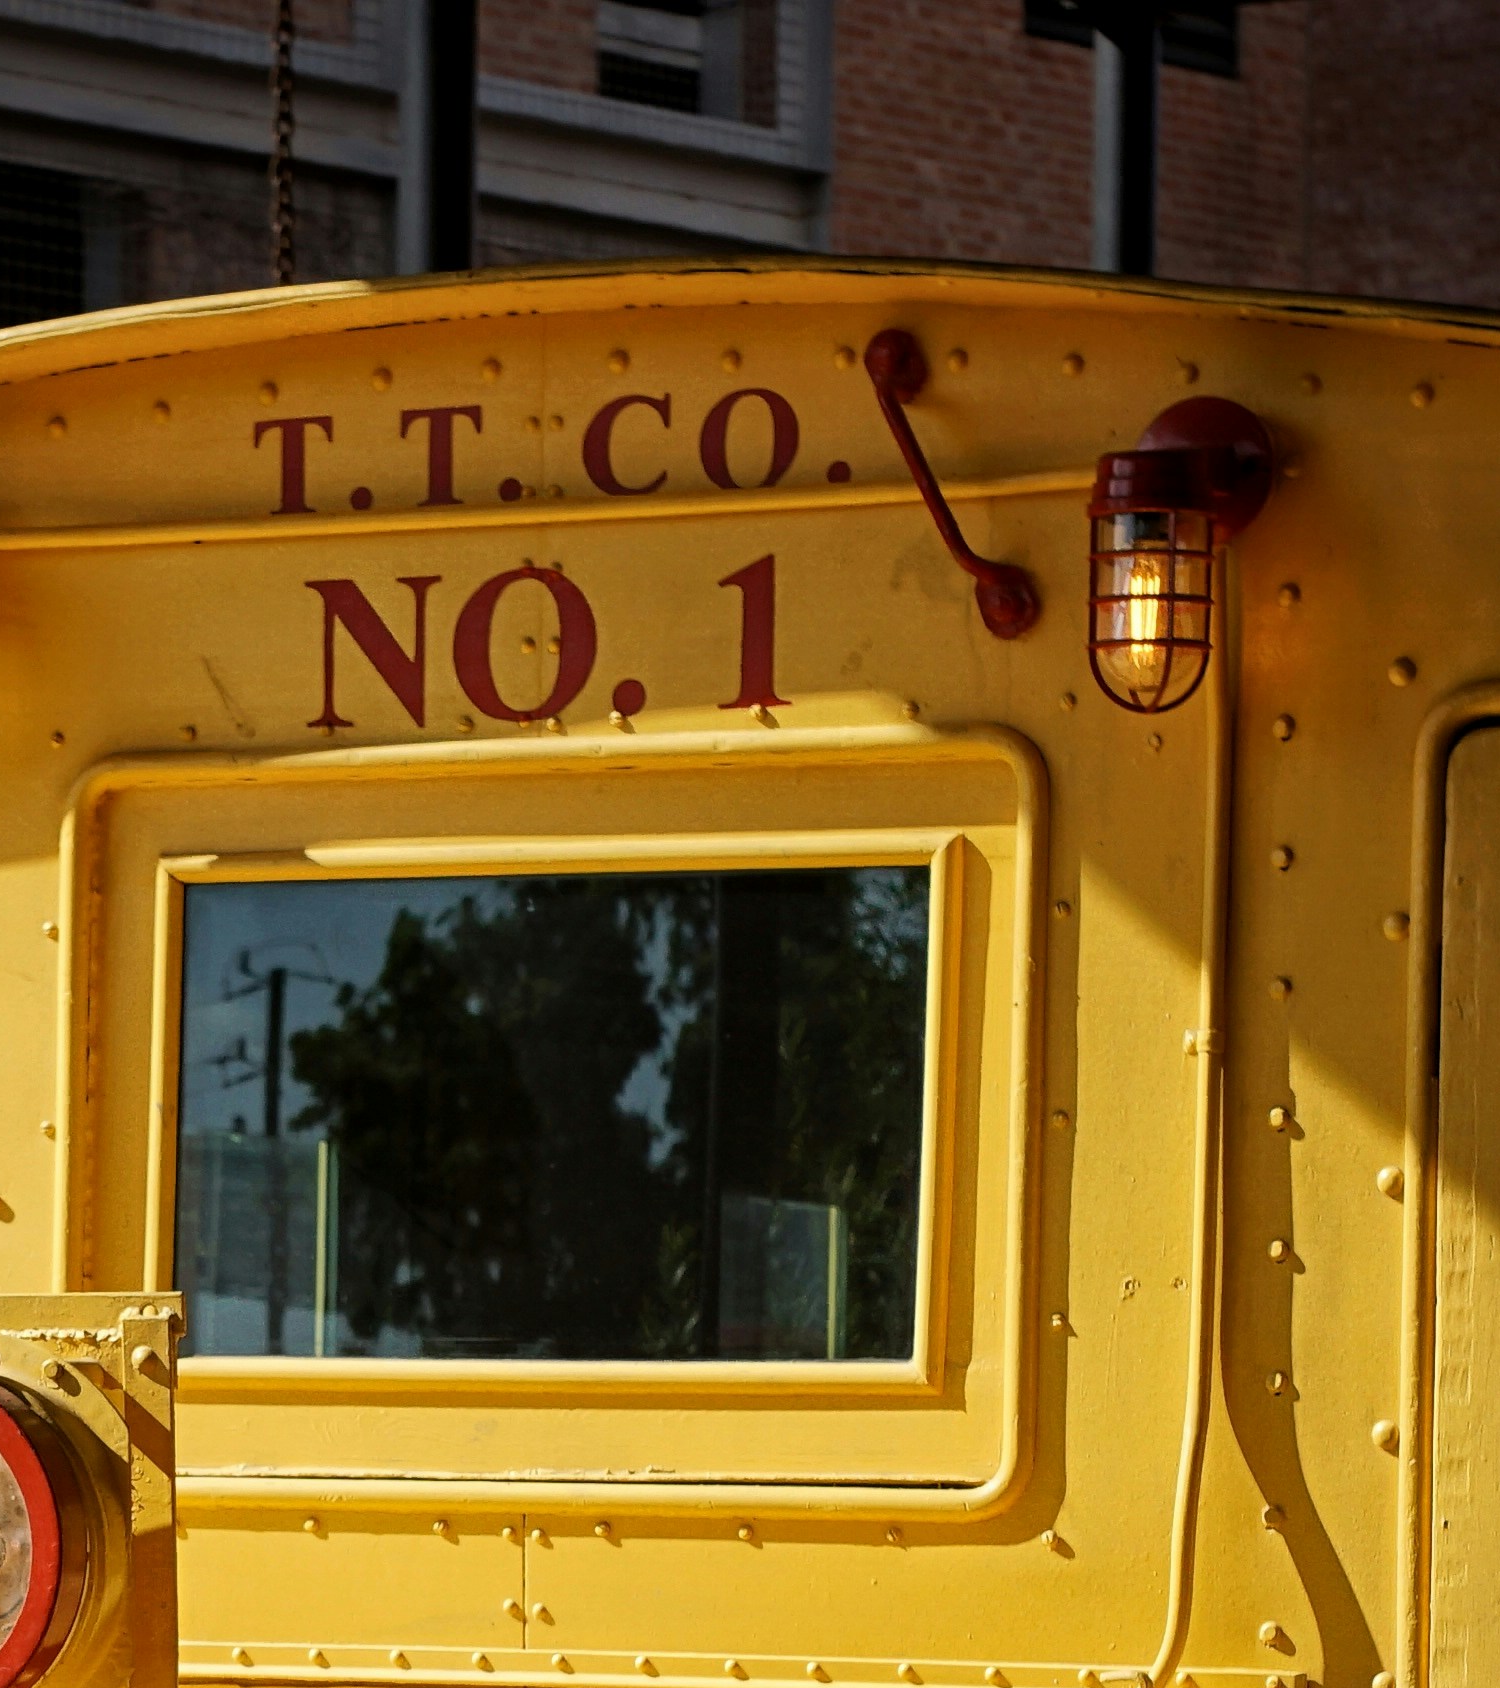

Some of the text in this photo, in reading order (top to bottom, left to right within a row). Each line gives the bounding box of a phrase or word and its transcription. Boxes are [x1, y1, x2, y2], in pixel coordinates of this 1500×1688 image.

[582, 386, 852, 497] CO.
[303, 553, 793, 730] NO. 1
